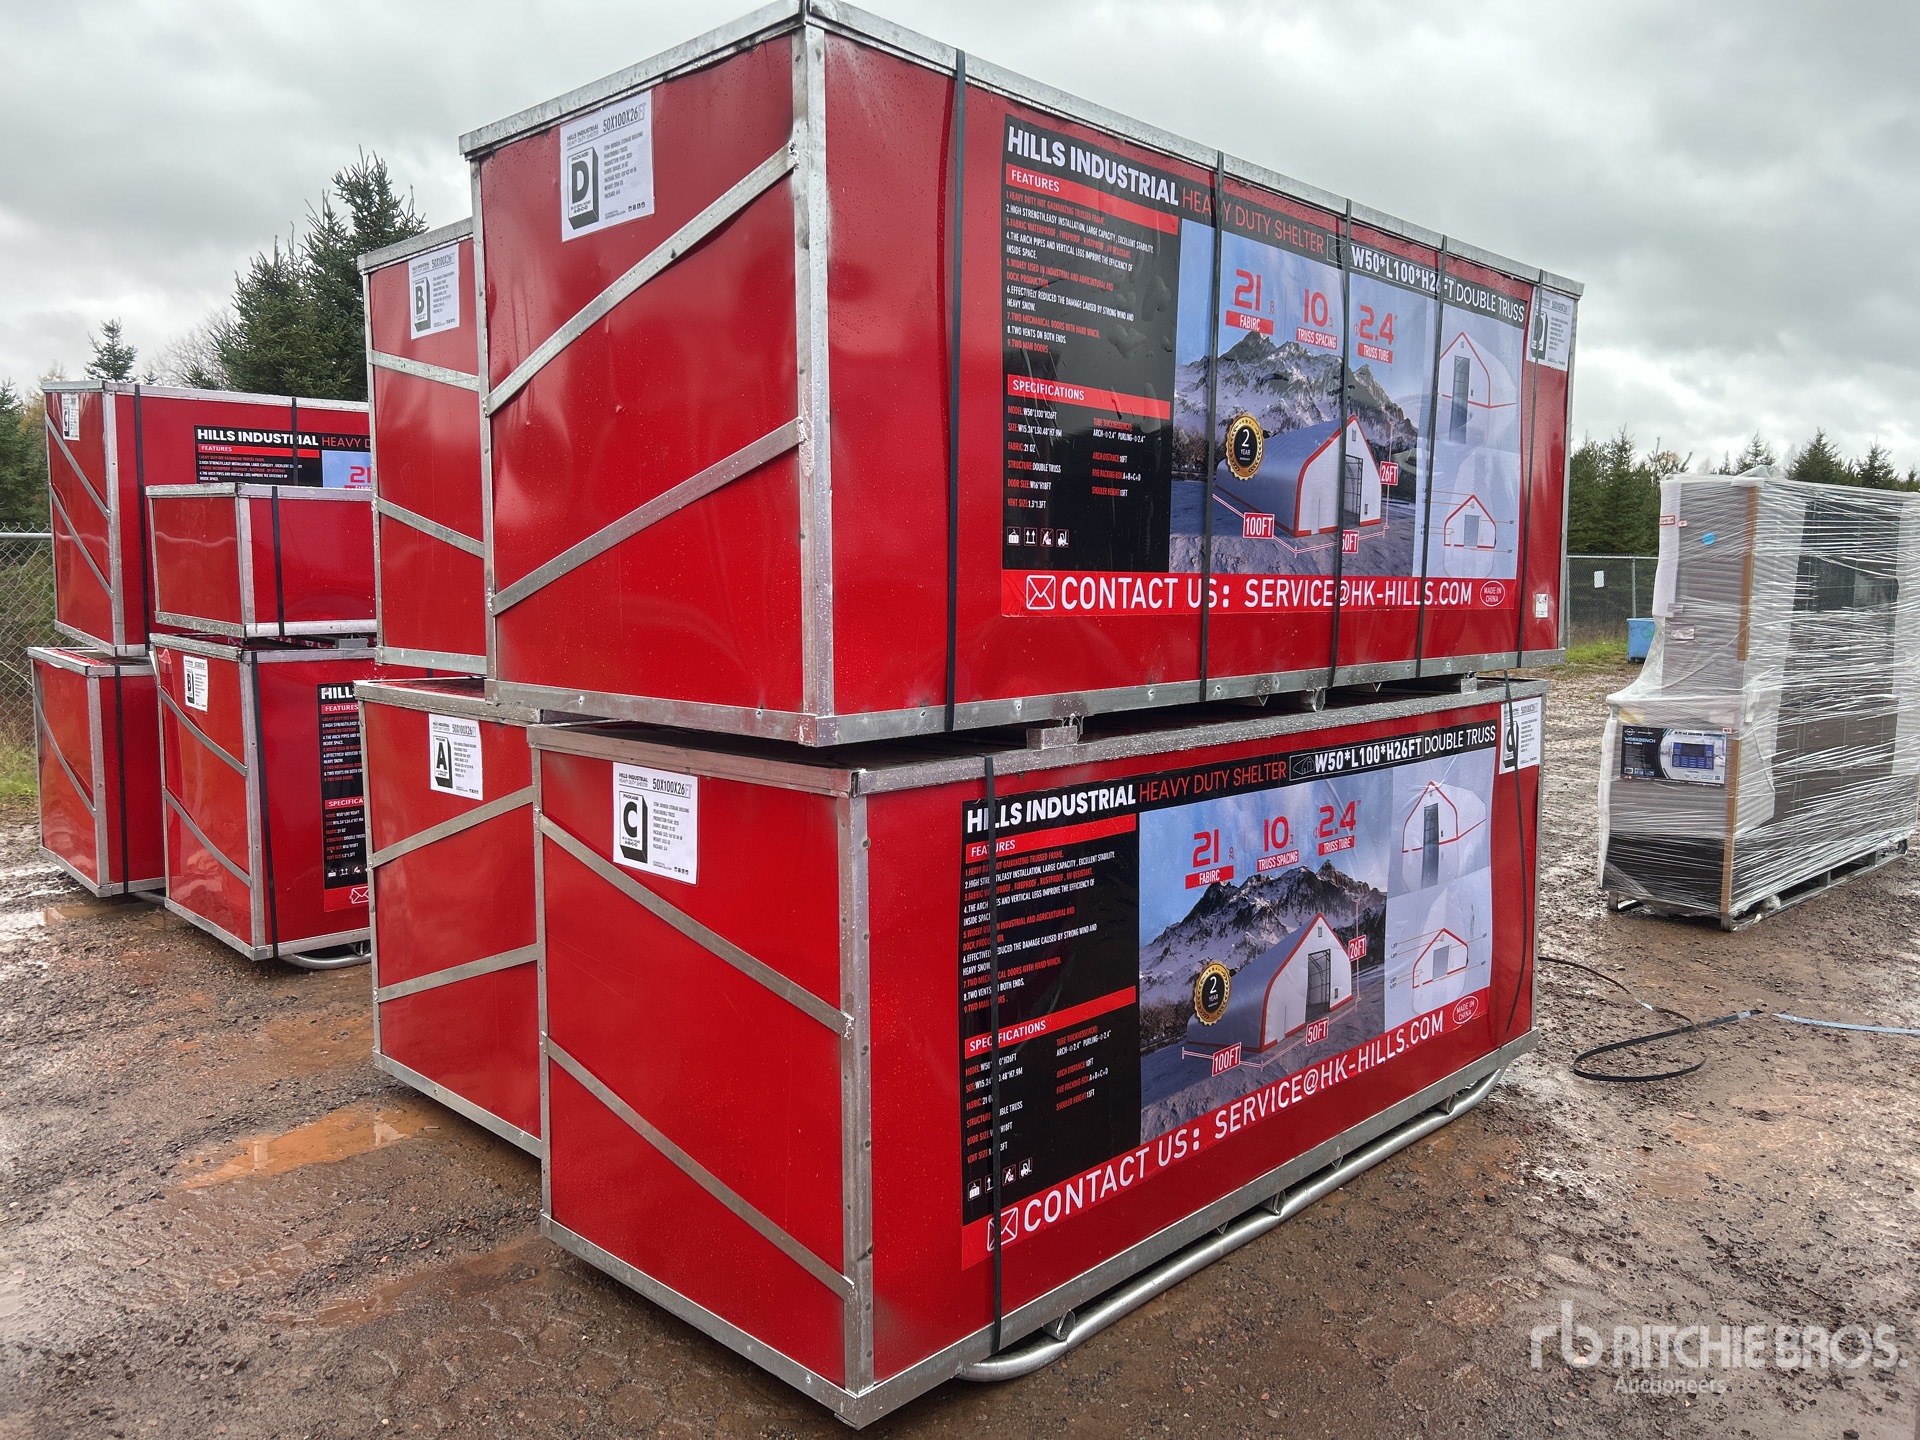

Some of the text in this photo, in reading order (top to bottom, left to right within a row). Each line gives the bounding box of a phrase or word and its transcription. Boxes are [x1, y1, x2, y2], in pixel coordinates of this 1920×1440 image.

[572, 161, 589, 204] D
[1011, 169, 1060, 192] FEATURES
[1008, 126, 1066, 167] HILLS
[1070, 146, 1178, 206] INDUSTRIAL
[1235, 206, 1271, 236] DUTY
[1275, 220, 1324, 254] SHELTER
[1456, 283, 1496, 312] DOUBLE
[1498, 297, 1525, 322] TRUSS
[415, 286, 424, 315] B
[1234, 269, 1262, 312] 21
[1304, 288, 1328, 327] 10
[1239, 315, 1261, 331] FABIRC
[1298, 328, 1337, 349] TRUSS SPACING
[1363, 344, 1376, 359] TRUSS
[1013, 380, 1085, 400] SPECIFICATIONS
[197, 429, 236, 442] HILLS
[322, 436, 360, 448] HEAVY
[1241, 429, 1250, 447] 2
[349, 466, 371, 483] 21
[1381, 465, 1397, 483] 26FT
[1245, 514, 1274, 537] 100FT
[1062, 576, 1472, 610] CONTACT US: SERVICE@HK-HILLS.COM
[321, 686, 354, 699] HILL
[436, 742, 448, 770] A
[967, 802, 1022, 834] HILS
[1026, 784, 1136, 823] INDUSTRIAL
[1139, 776, 1190, 803] HEAVY
[1194, 770, 1230, 794] DUTY
[1233, 761, 1287, 787] SHELTER
[1424, 730, 1464, 754] DOUBLE
[1466, 725, 1496, 745] TRUSS
[329, 798, 364, 807] SPECIFICA
[623, 801, 637, 838] C
[1264, 816, 1289, 852] 10
[1324, 837, 1352, 853] TRUSS TUBE
[1193, 829, 1219, 868] 21
[1258, 851, 1298, 871] TRUSS SPACING
[1200, 870, 1220, 885] FABIRC
[1350, 938, 1366, 960] 26FT
[1209, 976, 1217, 994] 2
[1457, 1002, 1469, 1014] MADE
[1459, 1010, 1471, 1020] CHINA
[970, 1020, 1046, 1052] SPECFICATIONS
[1308, 1020, 1328, 1042] 50FT
[1214, 1046, 1240, 1073] 100FT
[1024, 1010, 1443, 1232] CONTACT US: SERVICE@HK-HILLS.COM
